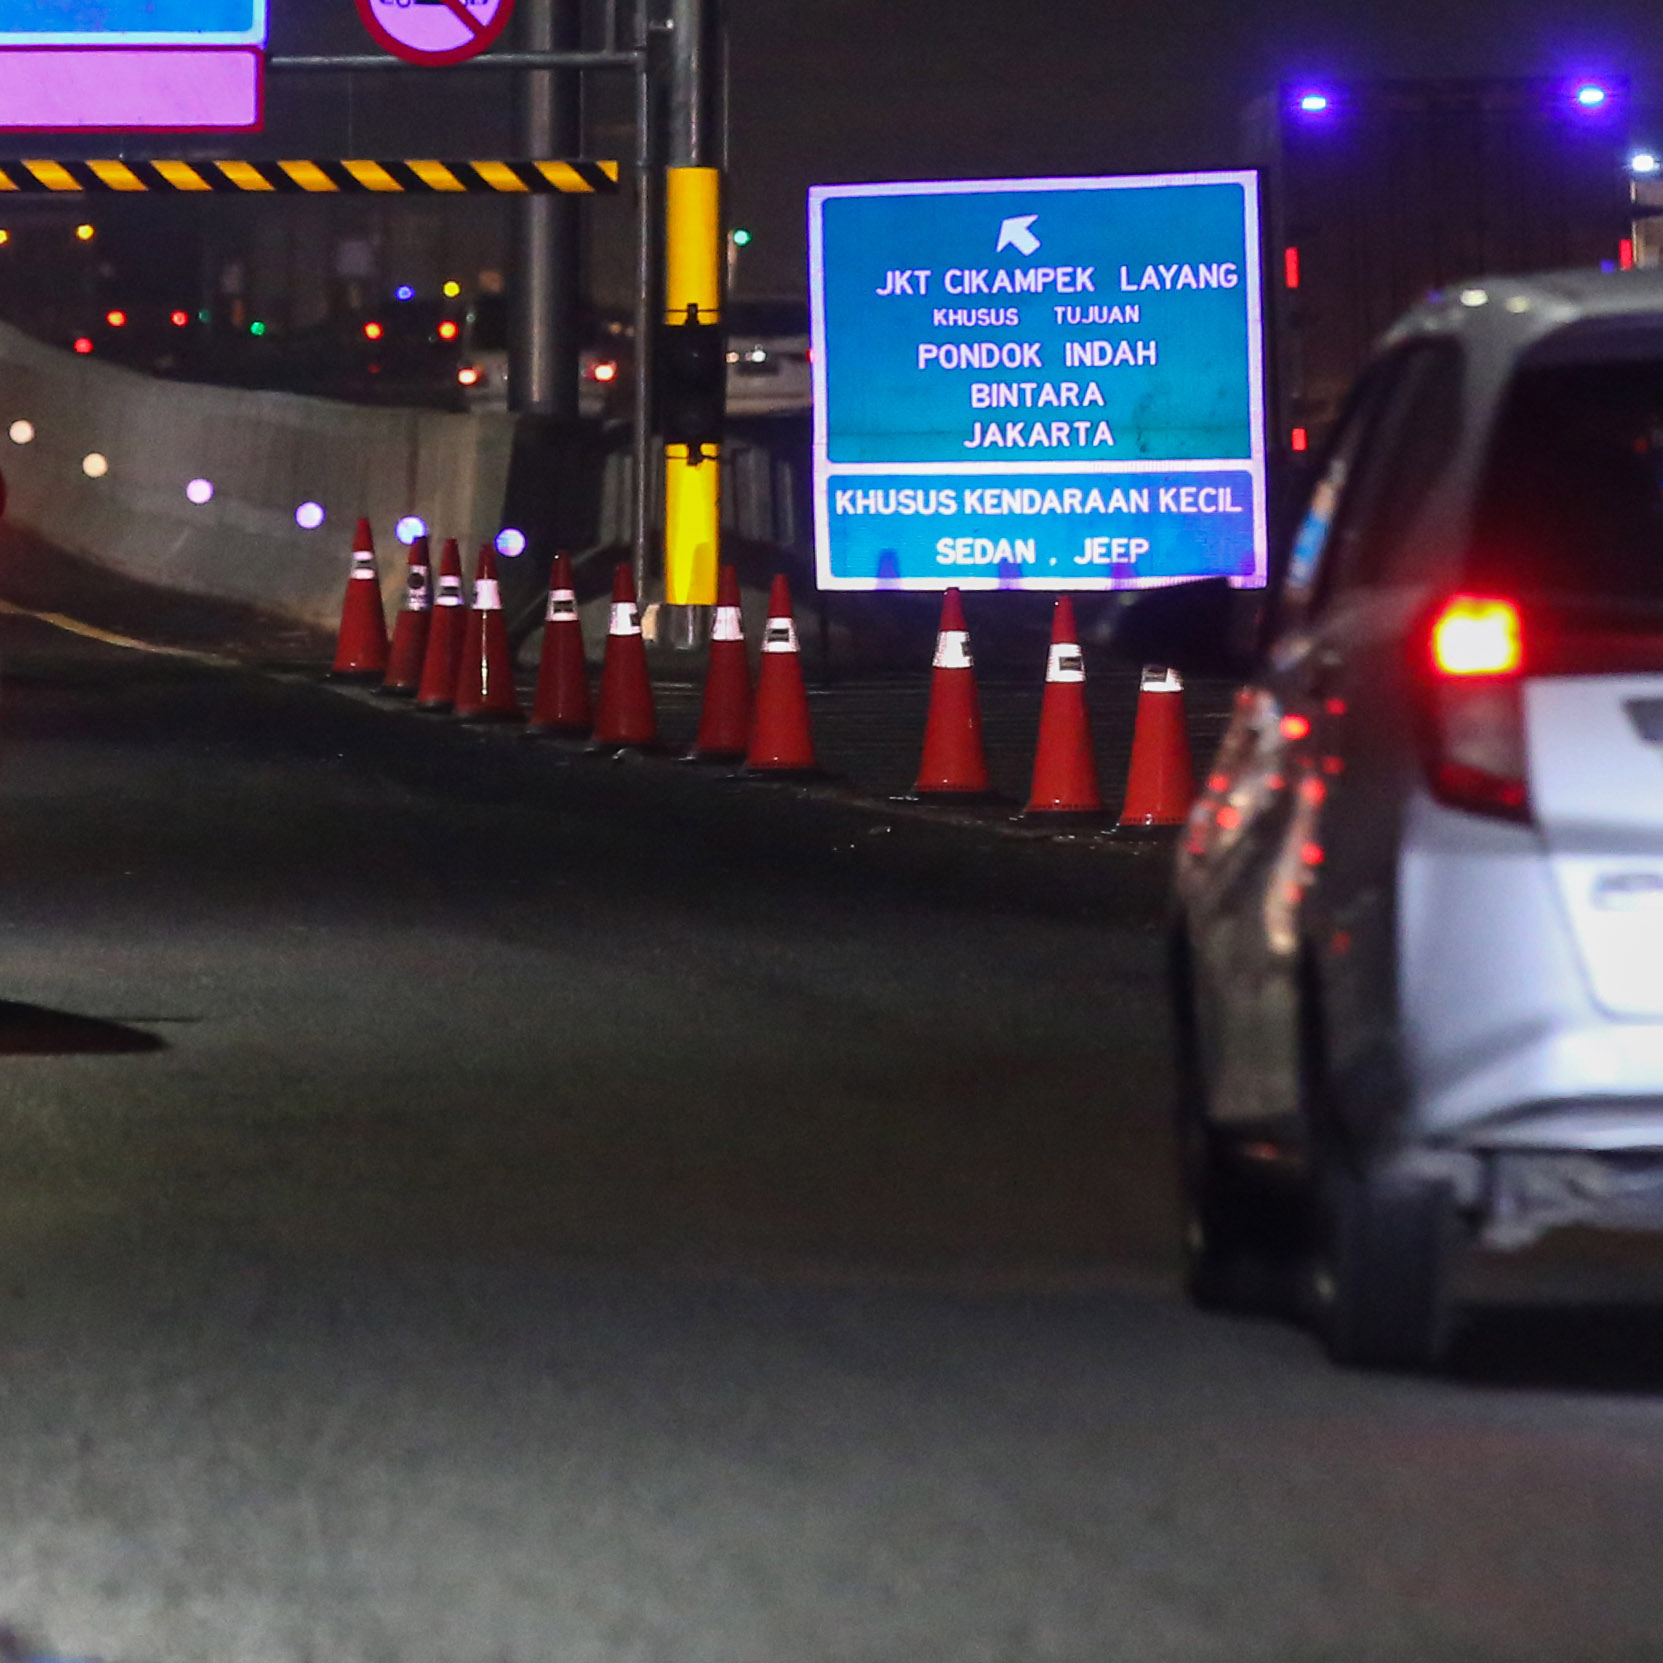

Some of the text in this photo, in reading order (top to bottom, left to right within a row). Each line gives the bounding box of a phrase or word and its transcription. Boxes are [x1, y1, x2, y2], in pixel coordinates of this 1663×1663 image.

[875, 262, 1240, 296] JKT CIKAMPEK LAYANG
[932, 304, 1141, 327] KHUSUS TUJUAN
[917, 340, 1158, 370] PONDOK INDAH
[970, 381, 1106, 409] BINTARA
[963, 420, 1116, 449] JAKARTA
[834, 486, 1244, 516] KHUSUS KENDARAAN KECIL
[935, 537, 1037, 566] SEDAN
[1073, 537, 1151, 565] JEEP
